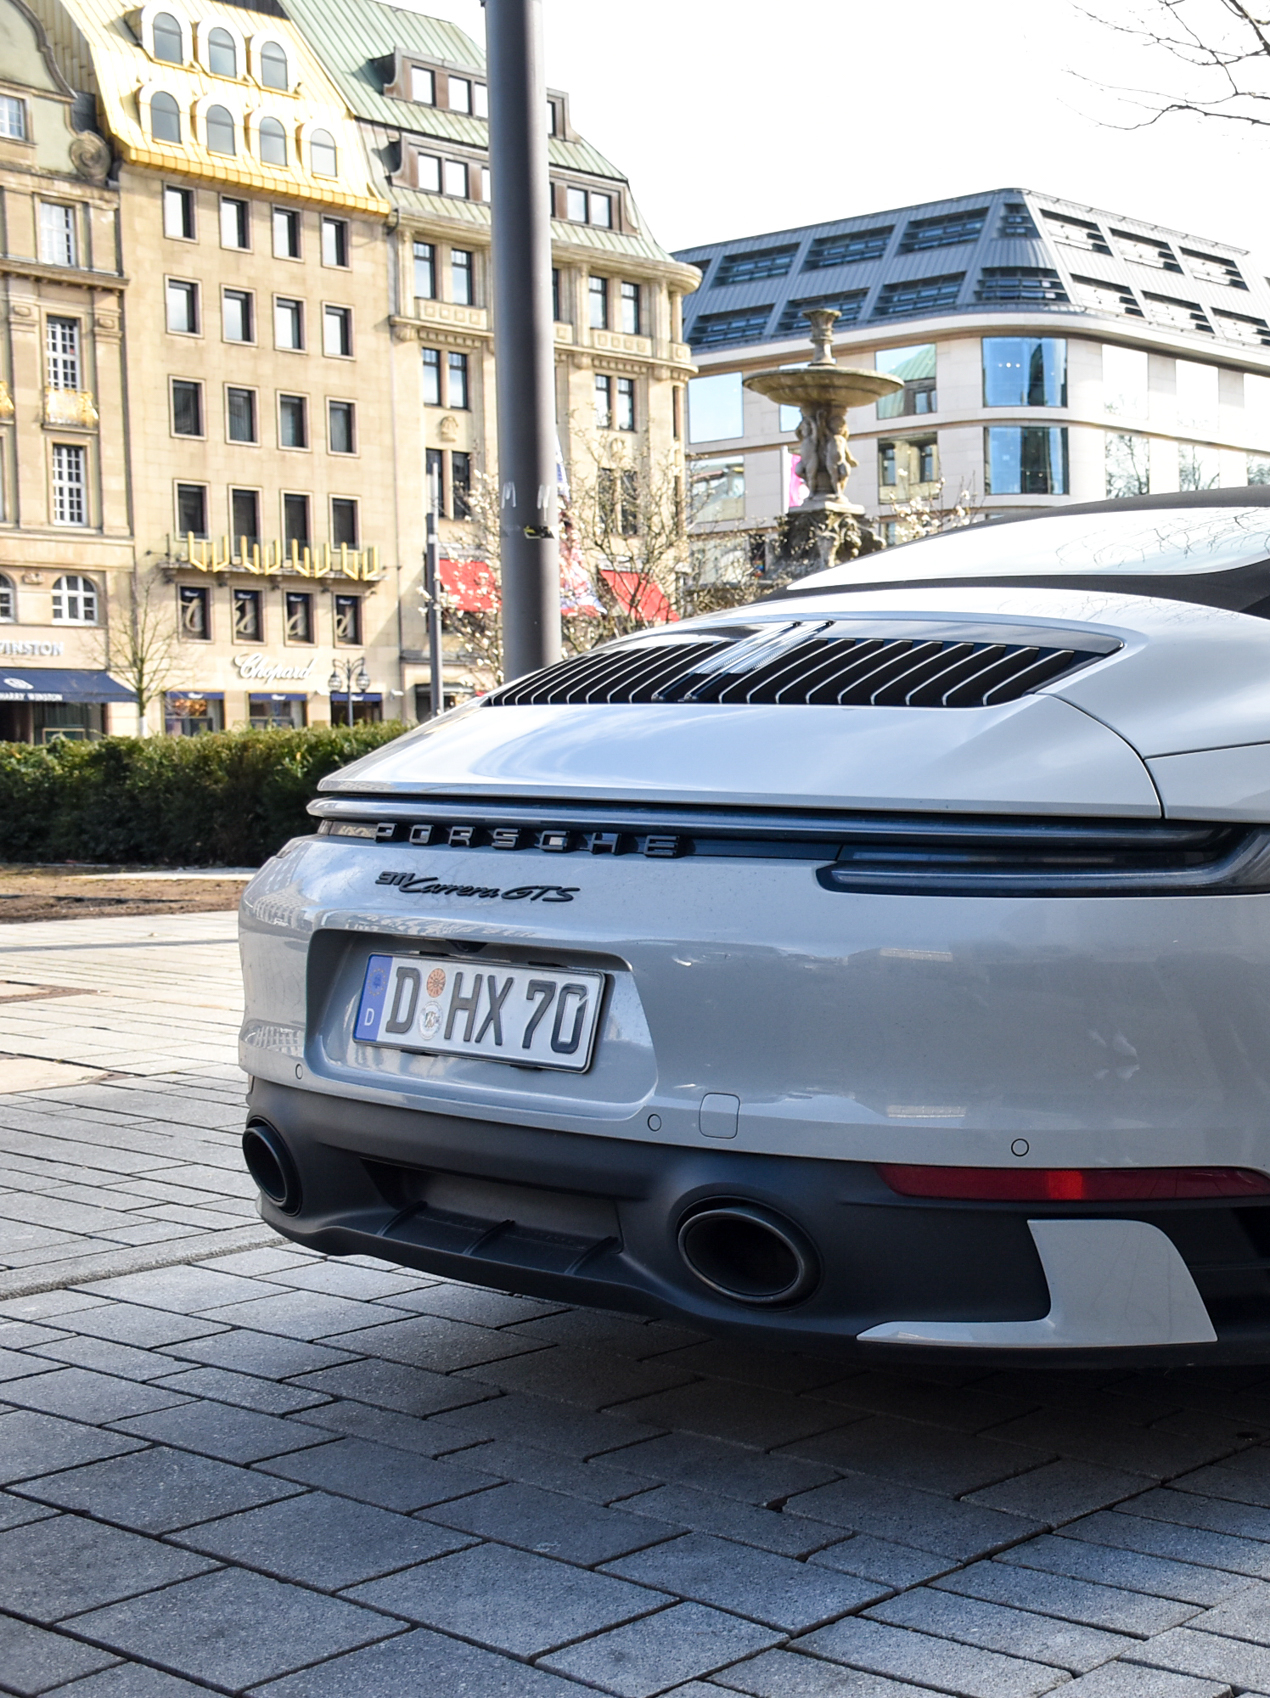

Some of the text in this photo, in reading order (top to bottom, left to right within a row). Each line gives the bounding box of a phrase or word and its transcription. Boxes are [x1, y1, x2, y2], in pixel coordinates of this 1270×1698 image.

[232, 652, 319, 686] Chopard
[374, 822, 682, 858] PORSCHE
[375, 871, 581, 902] 911 Carrera GTS
[363, 1008, 376, 1027] D
[385, 966, 590, 1055] D HX 70
